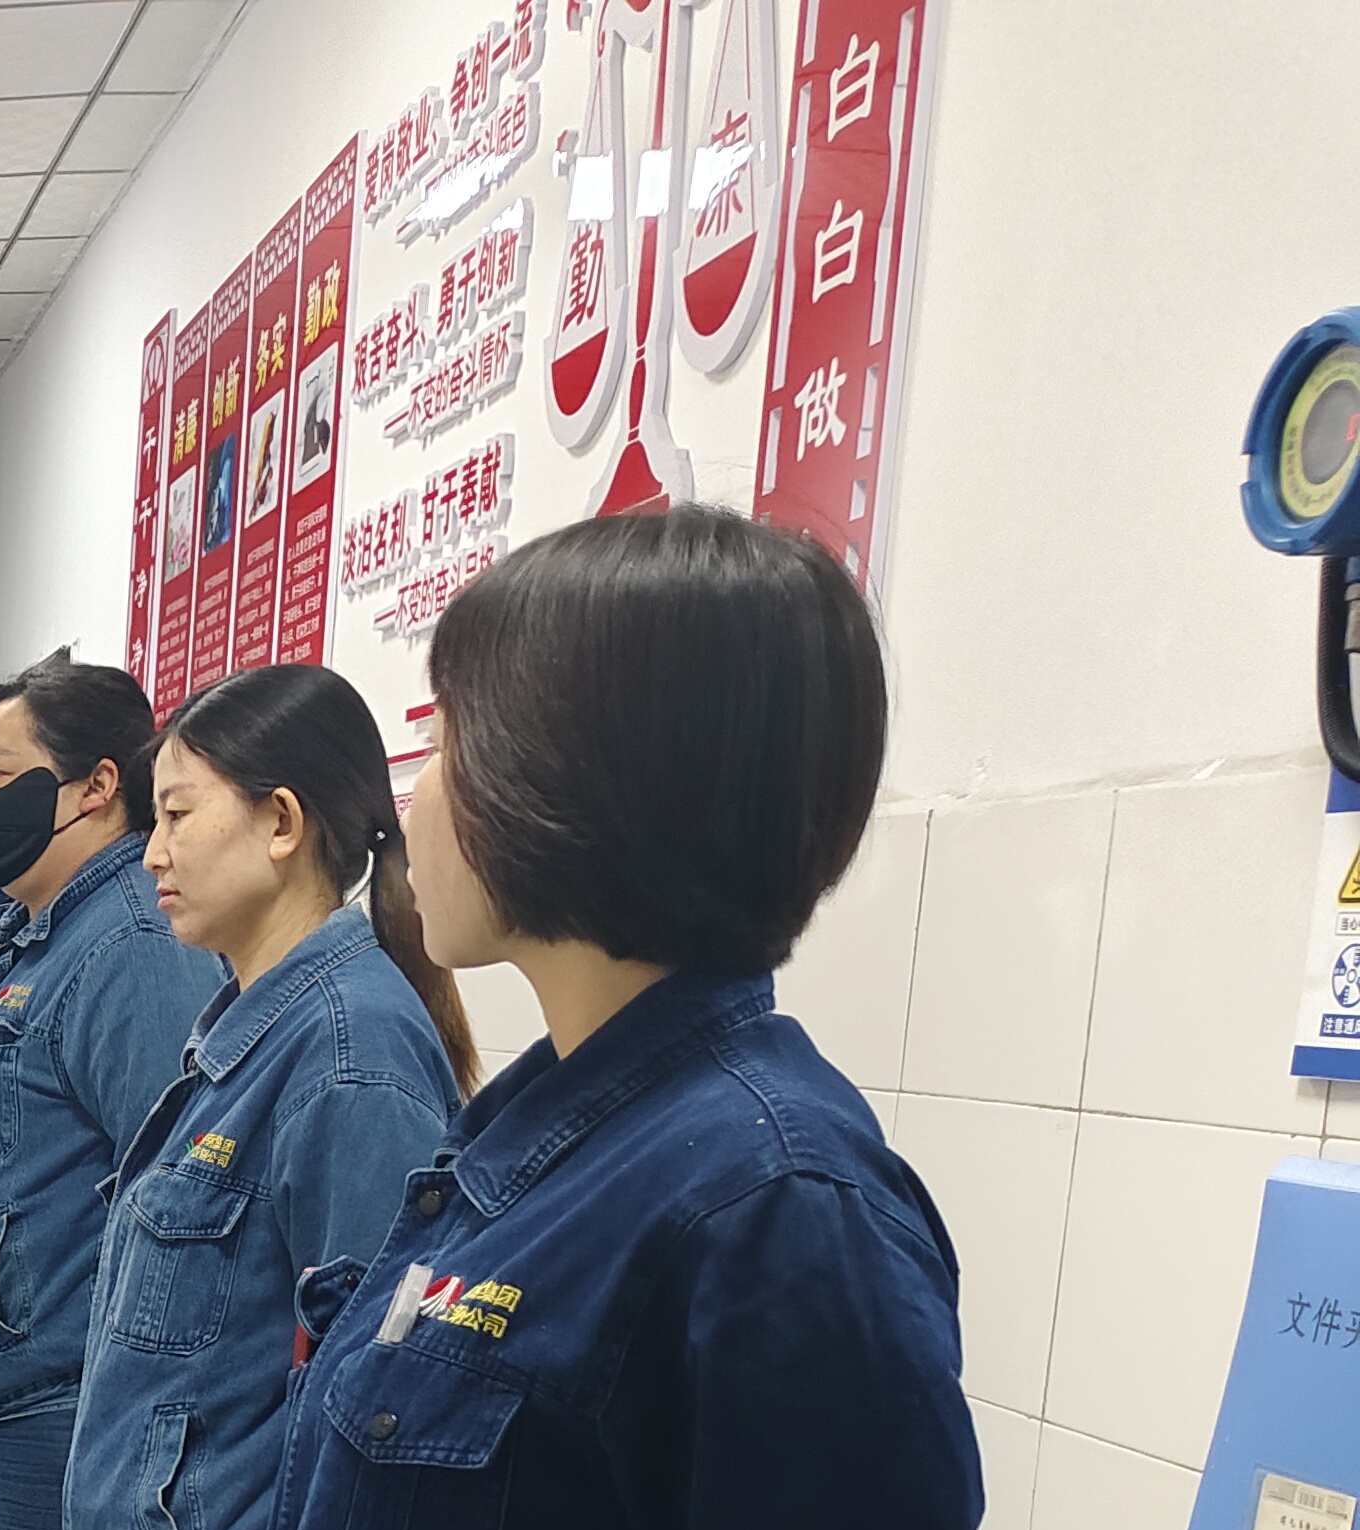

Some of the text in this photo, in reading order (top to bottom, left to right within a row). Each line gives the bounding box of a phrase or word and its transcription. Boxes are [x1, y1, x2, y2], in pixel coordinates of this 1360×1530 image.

[562, 227, 605, 332] 勤
[794, 33, 880, 462] 白白做
[304, 258, 342, 347] 勤政
[255, 311, 288, 394] 务实
[173, 397, 200, 465] 清廉
[130, 426, 157, 676] 干干净净
[342, 440, 502, 586] 淡泊名利、甘于奉献
[460, 1279, 523, 1313] 集团
